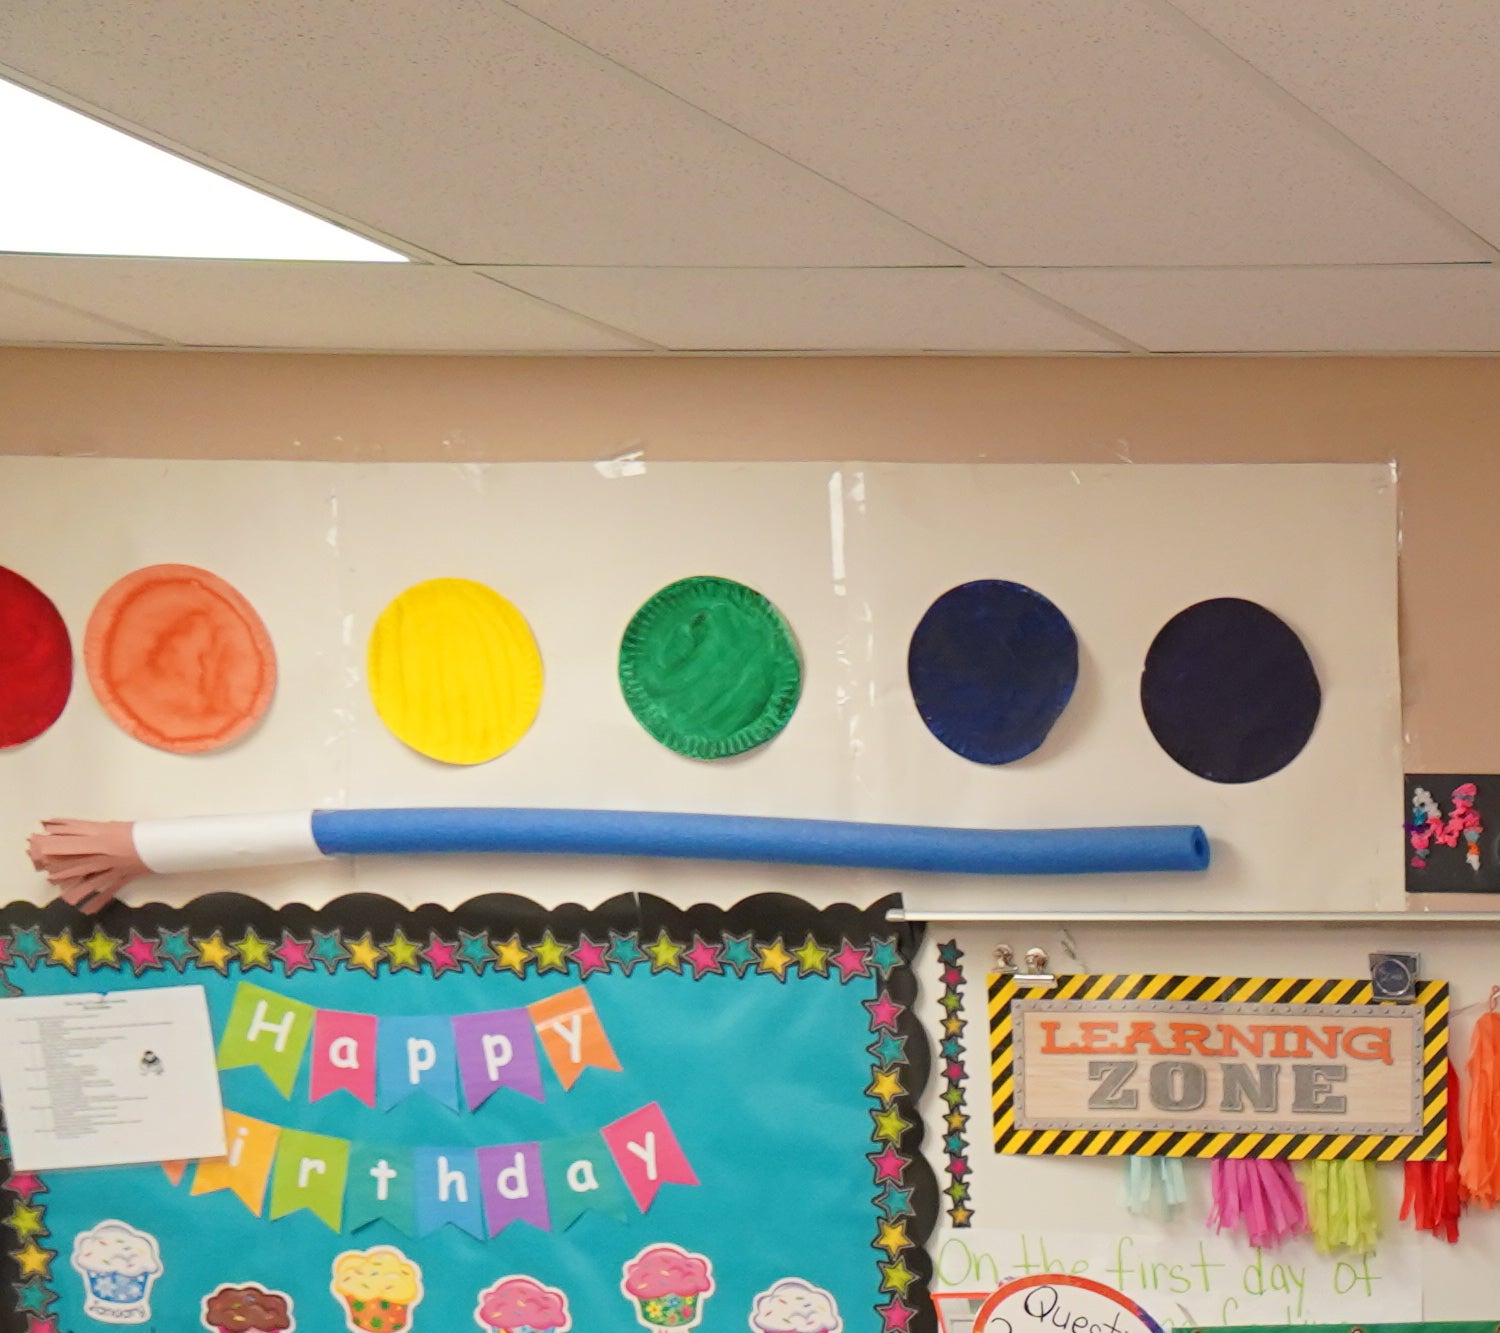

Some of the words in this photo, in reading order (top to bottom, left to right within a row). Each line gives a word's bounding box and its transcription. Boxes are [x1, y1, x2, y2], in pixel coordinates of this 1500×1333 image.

[247, 1000, 590, 1084] Happy
[1039, 1021, 1395, 1064] LEARNING
[1087, 1060, 1349, 1113] ZONE
[937, 1238, 997, 1287] On
[1110, 1237, 1225, 1293] first
[1242, 1247, 1303, 1318] day
[1333, 1251, 1383, 1298] of
